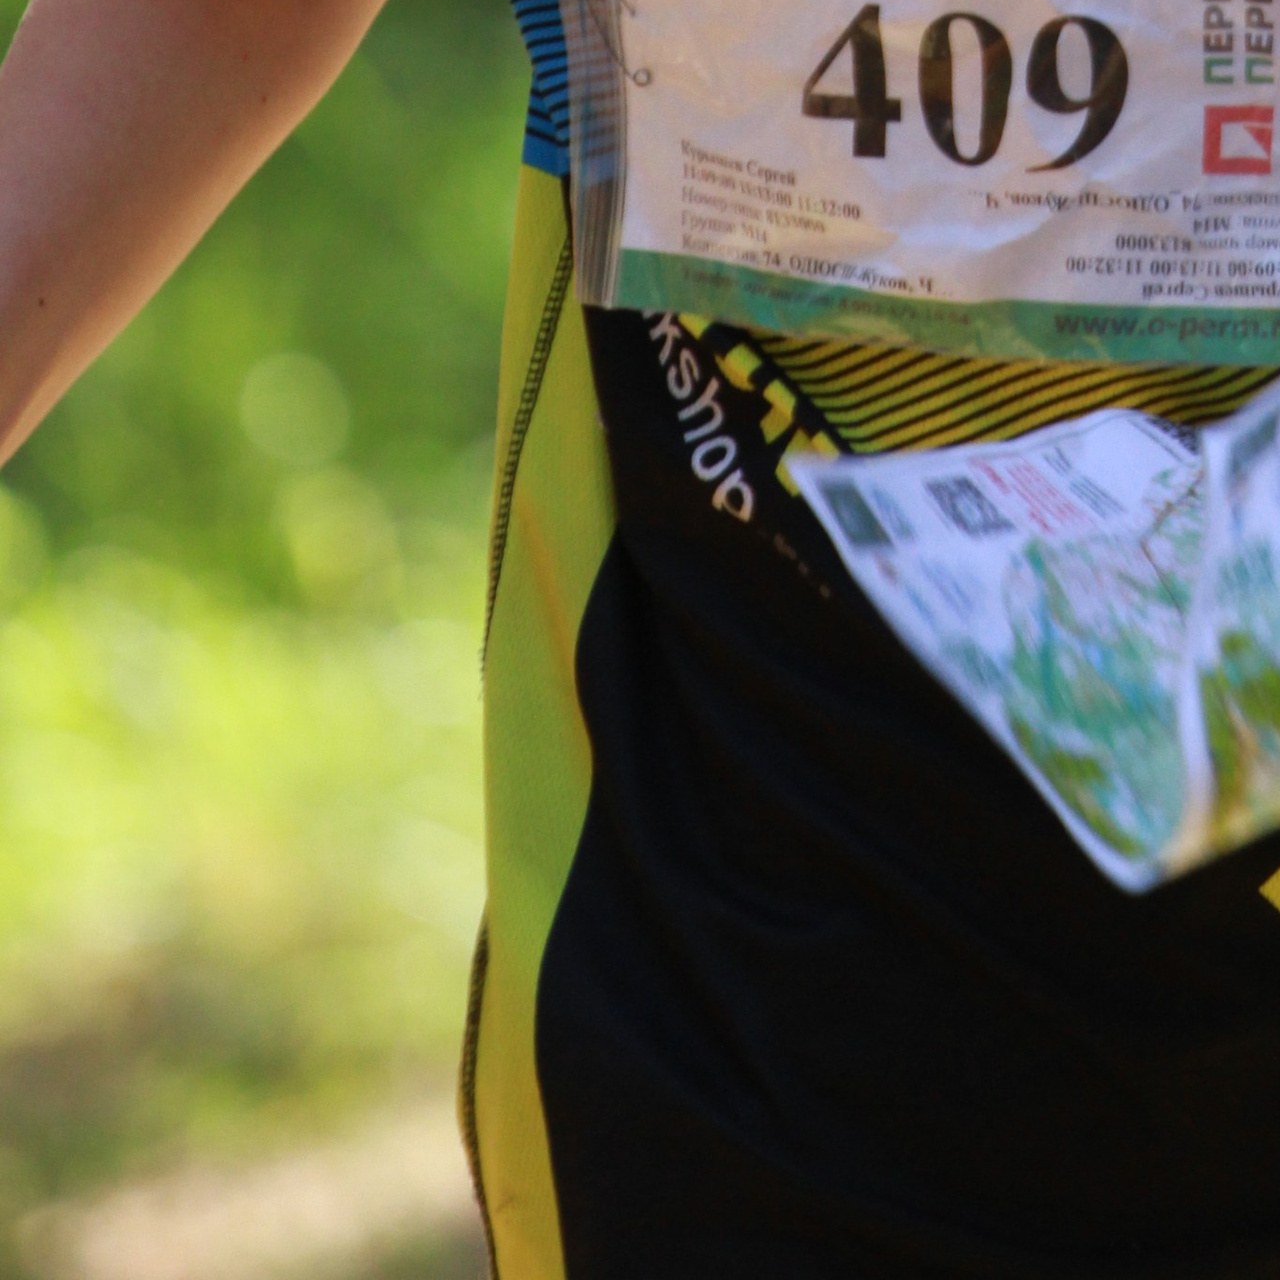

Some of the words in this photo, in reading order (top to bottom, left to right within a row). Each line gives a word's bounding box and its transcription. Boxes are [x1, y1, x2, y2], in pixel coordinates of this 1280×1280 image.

[802, 3, 1129, 174] 409
[797, 195, 862, 221] 11:32:00
[1066, 255, 1142, 275] 11:32:00
[1141, 281, 1209, 301] Сергей
[645, 311, 755, 523] kshop
